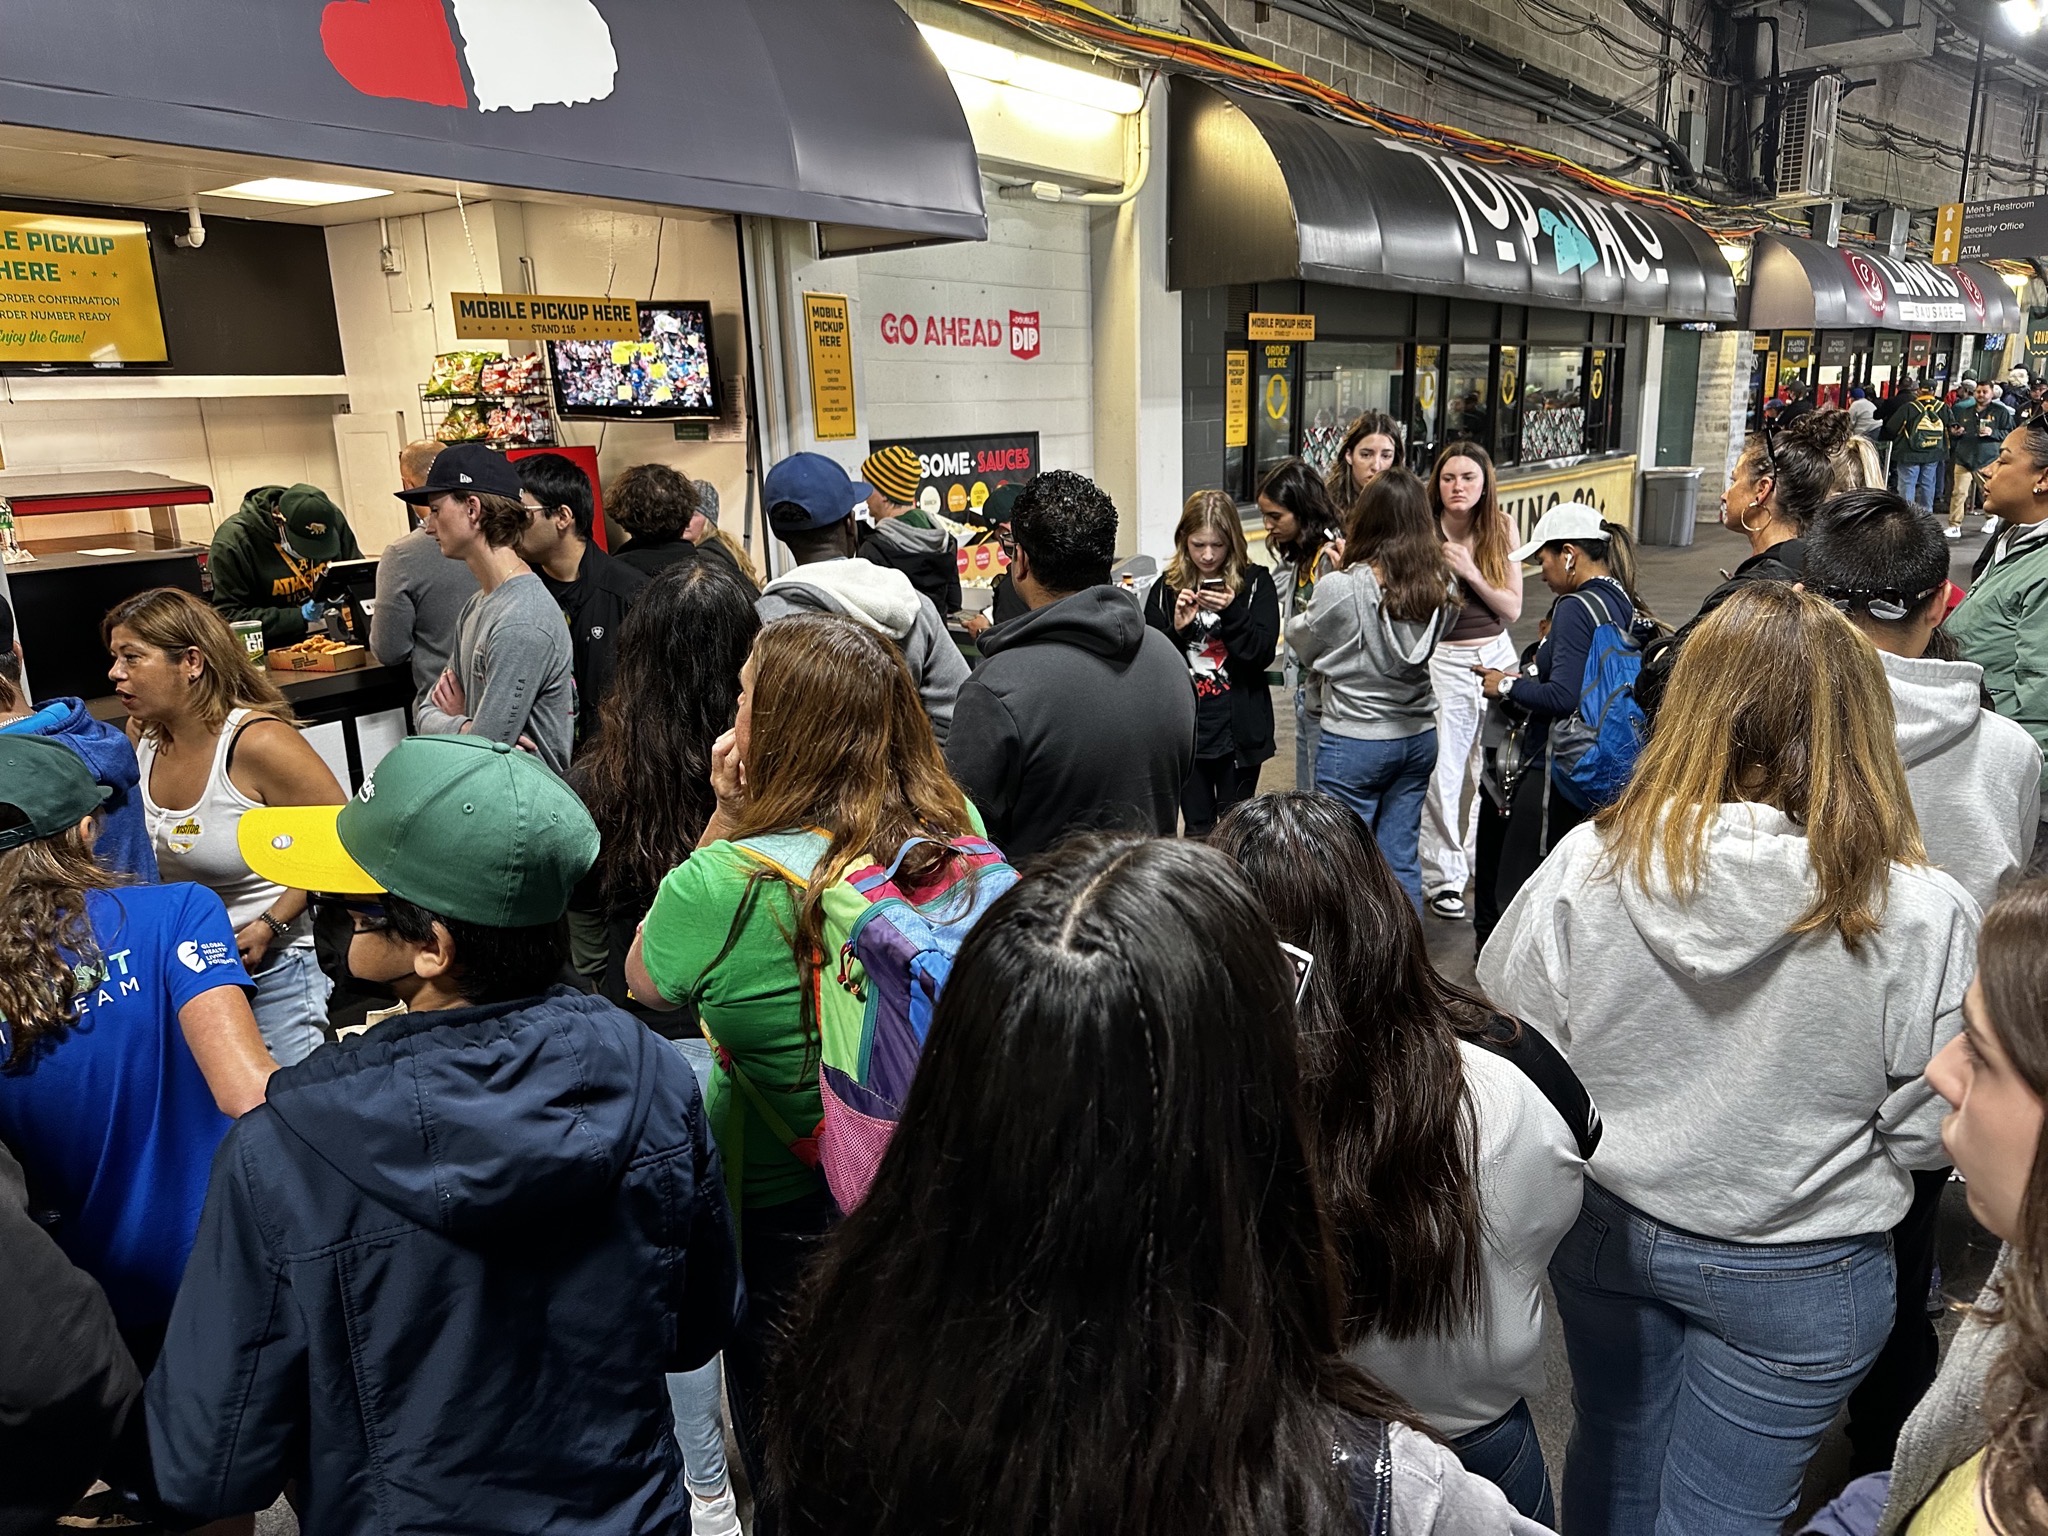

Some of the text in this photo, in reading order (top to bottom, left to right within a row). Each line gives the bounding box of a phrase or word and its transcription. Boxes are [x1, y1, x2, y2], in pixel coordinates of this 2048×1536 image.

[1373, 137, 1539, 265] TOP
[1966, 201, 2035, 214] Men's Restroom
[1963, 222, 2025, 234] Security Office
[0, 231, 115, 255] E PICKUP
[1961, 245, 1981, 255] ATM
[1865, 252, 1960, 298] LINKS
[38, 294, 120, 306] CONFIRMATION
[30, 310, 76, 321] NUMBER
[79, 312, 112, 322] READY
[460, 300, 632, 322] MOBILE PICKUP HERE
[812, 306, 844, 319] MOBILE
[1915, 303, 1954, 319] SAUSAGE
[532, 324, 576, 334] STAND 116
[814, 320, 844, 333] PICKUP
[880, 312, 1003, 347] GO AHEAD
[1251, 317, 1312, 329] MOBILE PICKUP HERE
[29, 330, 47, 343] the
[50, 330, 86, 344] Game!
[819, 335, 842, 348] HERE
[1012, 326, 1039, 351] DIP
[1265, 345, 1290, 356] ORDER
[1267, 357, 1287, 368] HERE
[920, 448, 1030, 478] SOME SAUCES
[508, 705, 519, 724] THE
[515, 679, 526, 698] SEA
[200, 941, 226, 949] GLOBAL
[74, 977, 140, 1015] EAM
